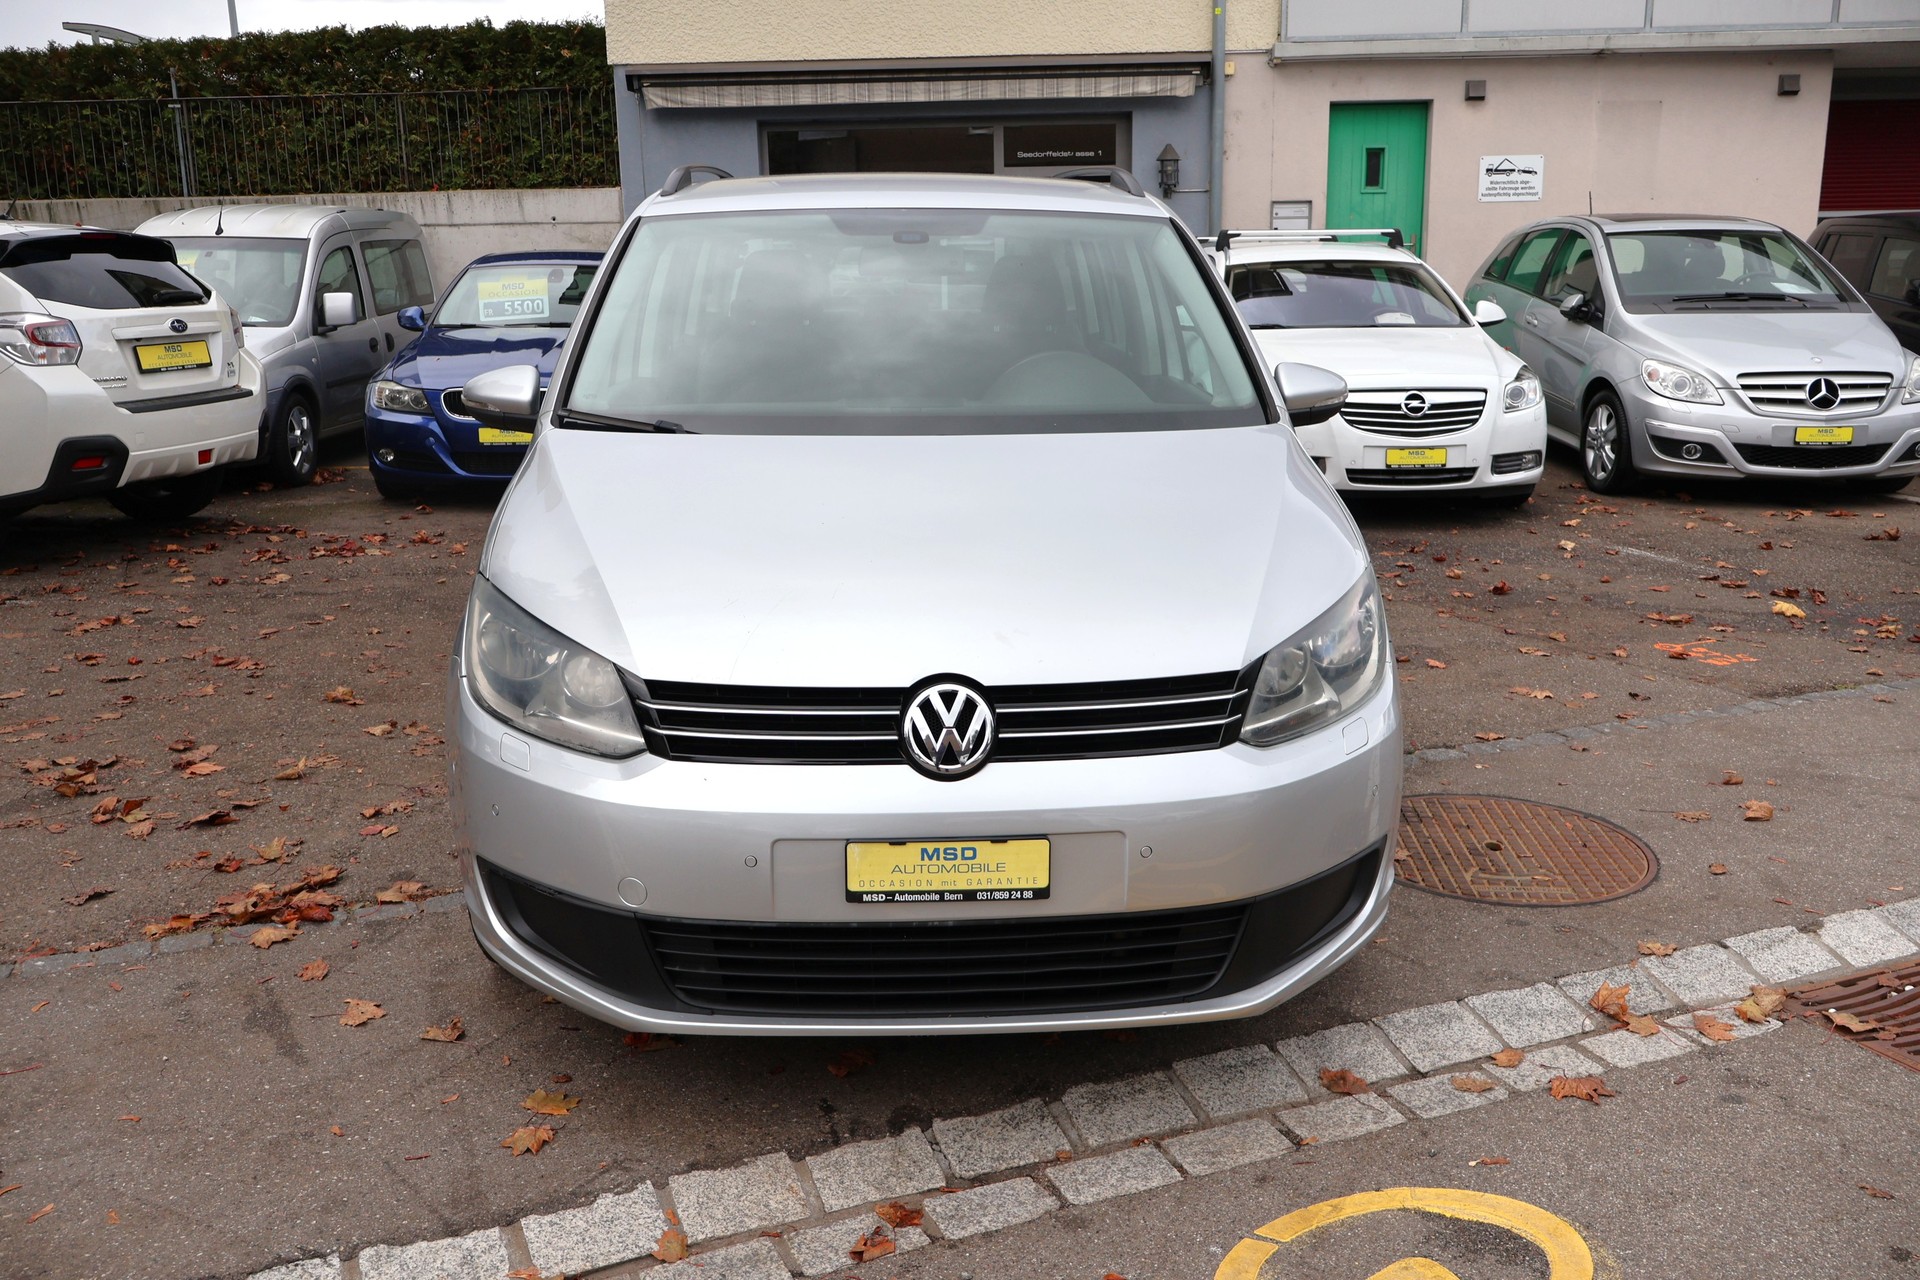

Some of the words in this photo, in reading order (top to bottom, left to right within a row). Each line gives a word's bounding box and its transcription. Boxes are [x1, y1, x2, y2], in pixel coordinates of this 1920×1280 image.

[501, 282, 525, 291] MSD
[488, 289, 539, 298] OCCASION
[504, 299, 543, 315] 5500
[164, 345, 182, 353] MSD
[157, 352, 192, 360] AUTOMOBILE
[905, 685, 992, 772] VW
[920, 847, 977, 861] MSD
[890, 862, 1006, 874] AUTOMOBILE
[858, 880, 933, 888] OCCASION
[941, 879, 957, 887] mit
[966, 877, 1038, 886] GARANTIE
[894, 893, 940, 901] Automobile
[944, 892, 963, 901] Bern
[976, 891, 1009, 900] 031/859
[1011, 890, 1021, 899] 24
[1023, 890, 1033, 899] 88
